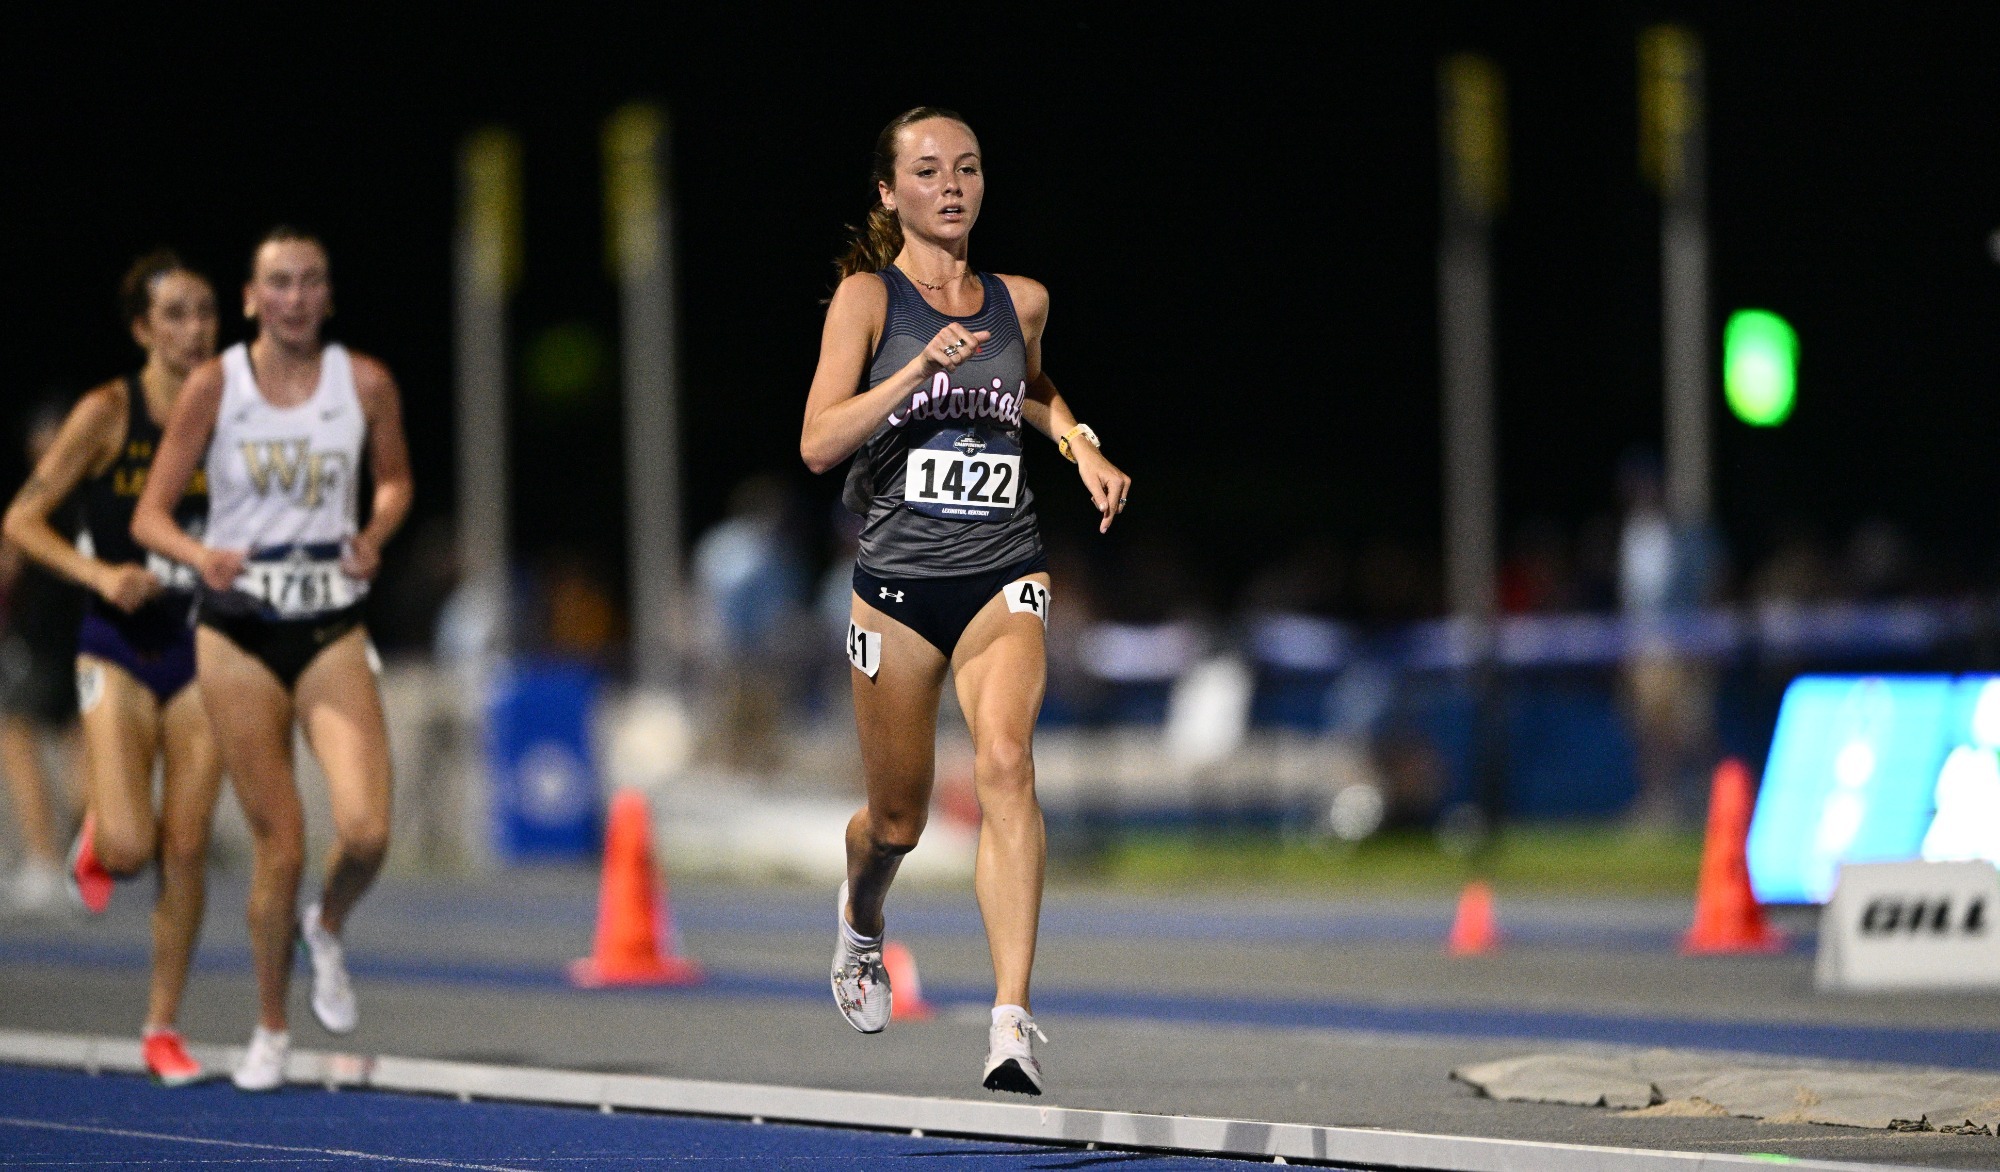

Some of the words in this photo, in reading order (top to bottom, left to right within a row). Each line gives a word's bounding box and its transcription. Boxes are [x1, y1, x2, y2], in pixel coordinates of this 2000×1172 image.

[919, 458, 1013, 504] 1422
[1019, 582, 1047, 624] 41
[850, 623, 867, 668] 41
[1859, 895, 1987, 936] GILL
